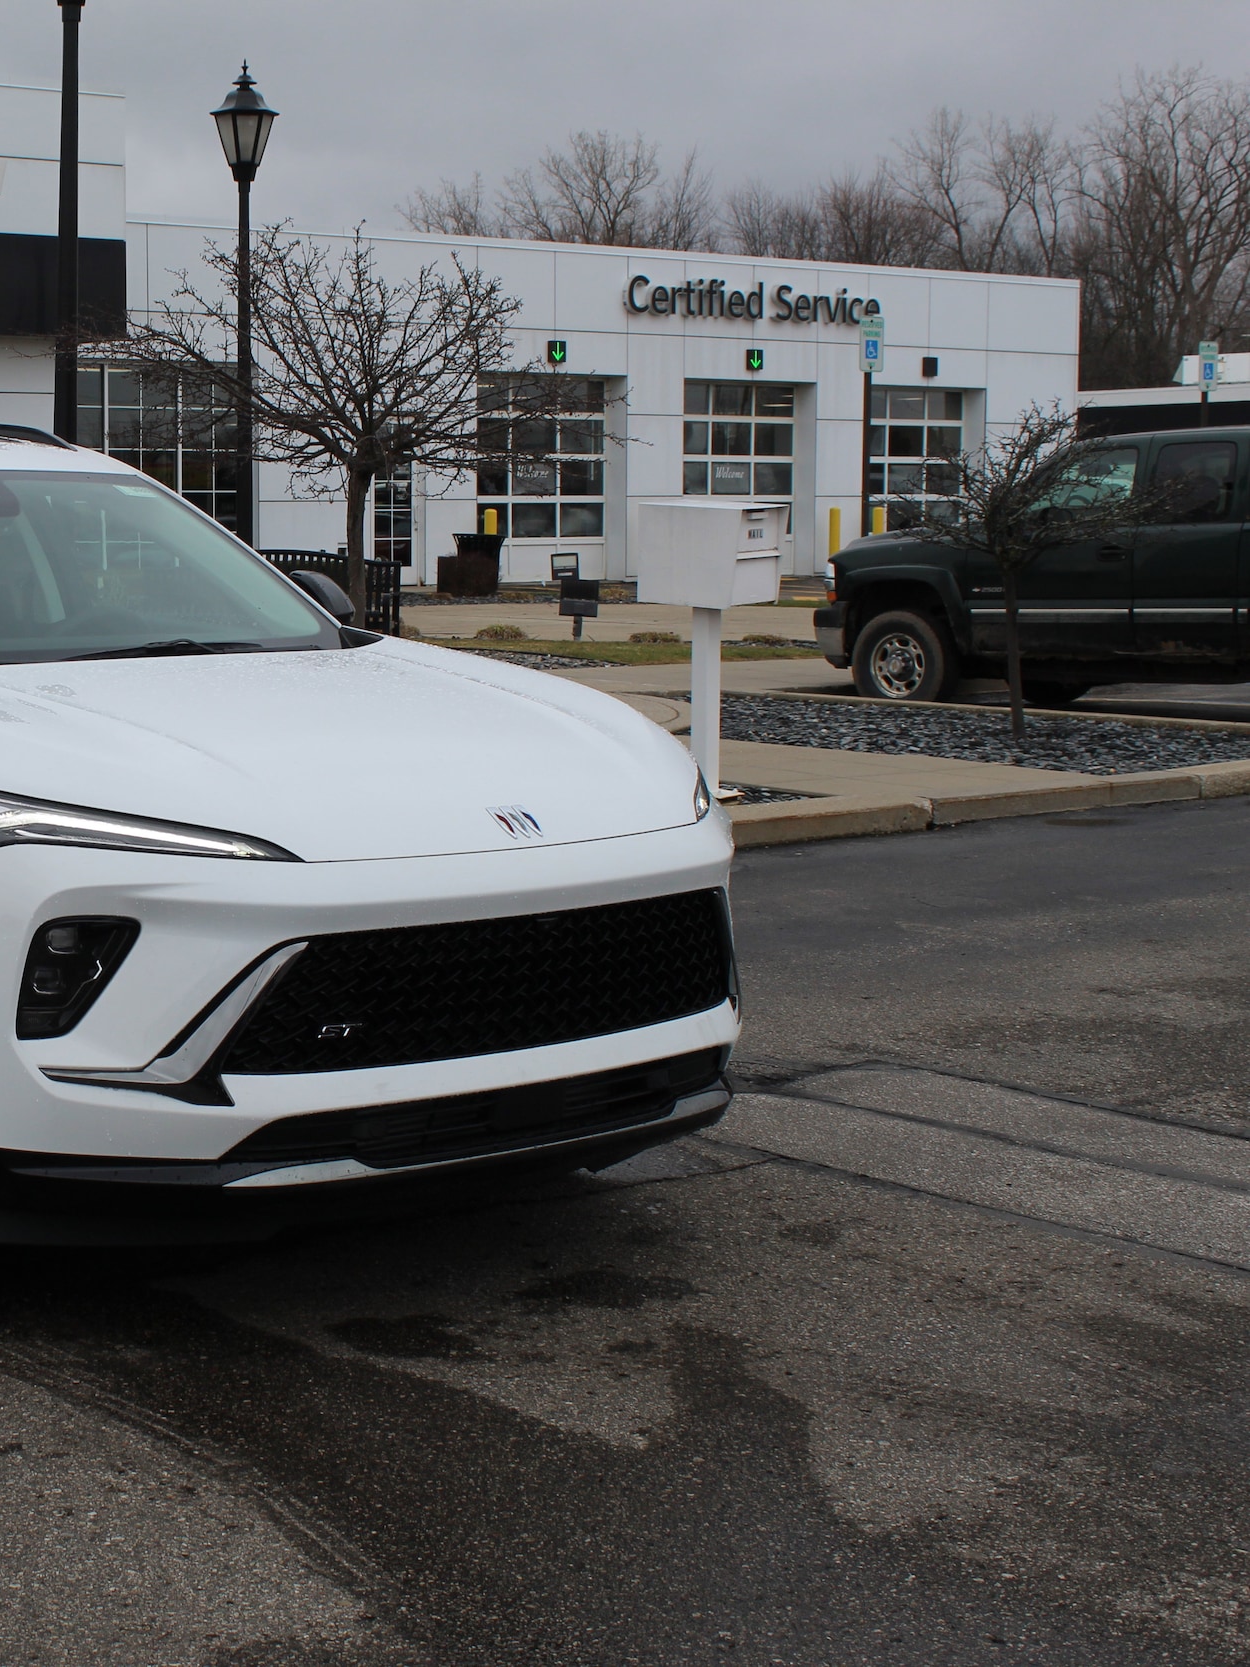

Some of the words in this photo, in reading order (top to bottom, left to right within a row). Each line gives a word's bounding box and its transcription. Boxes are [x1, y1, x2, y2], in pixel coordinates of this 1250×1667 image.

[627, 274, 764, 320] Certified
[715, 466, 745, 479] Welcome
[747, 528, 763, 539] MAIL
[317, 1023, 362, 1039] ST
